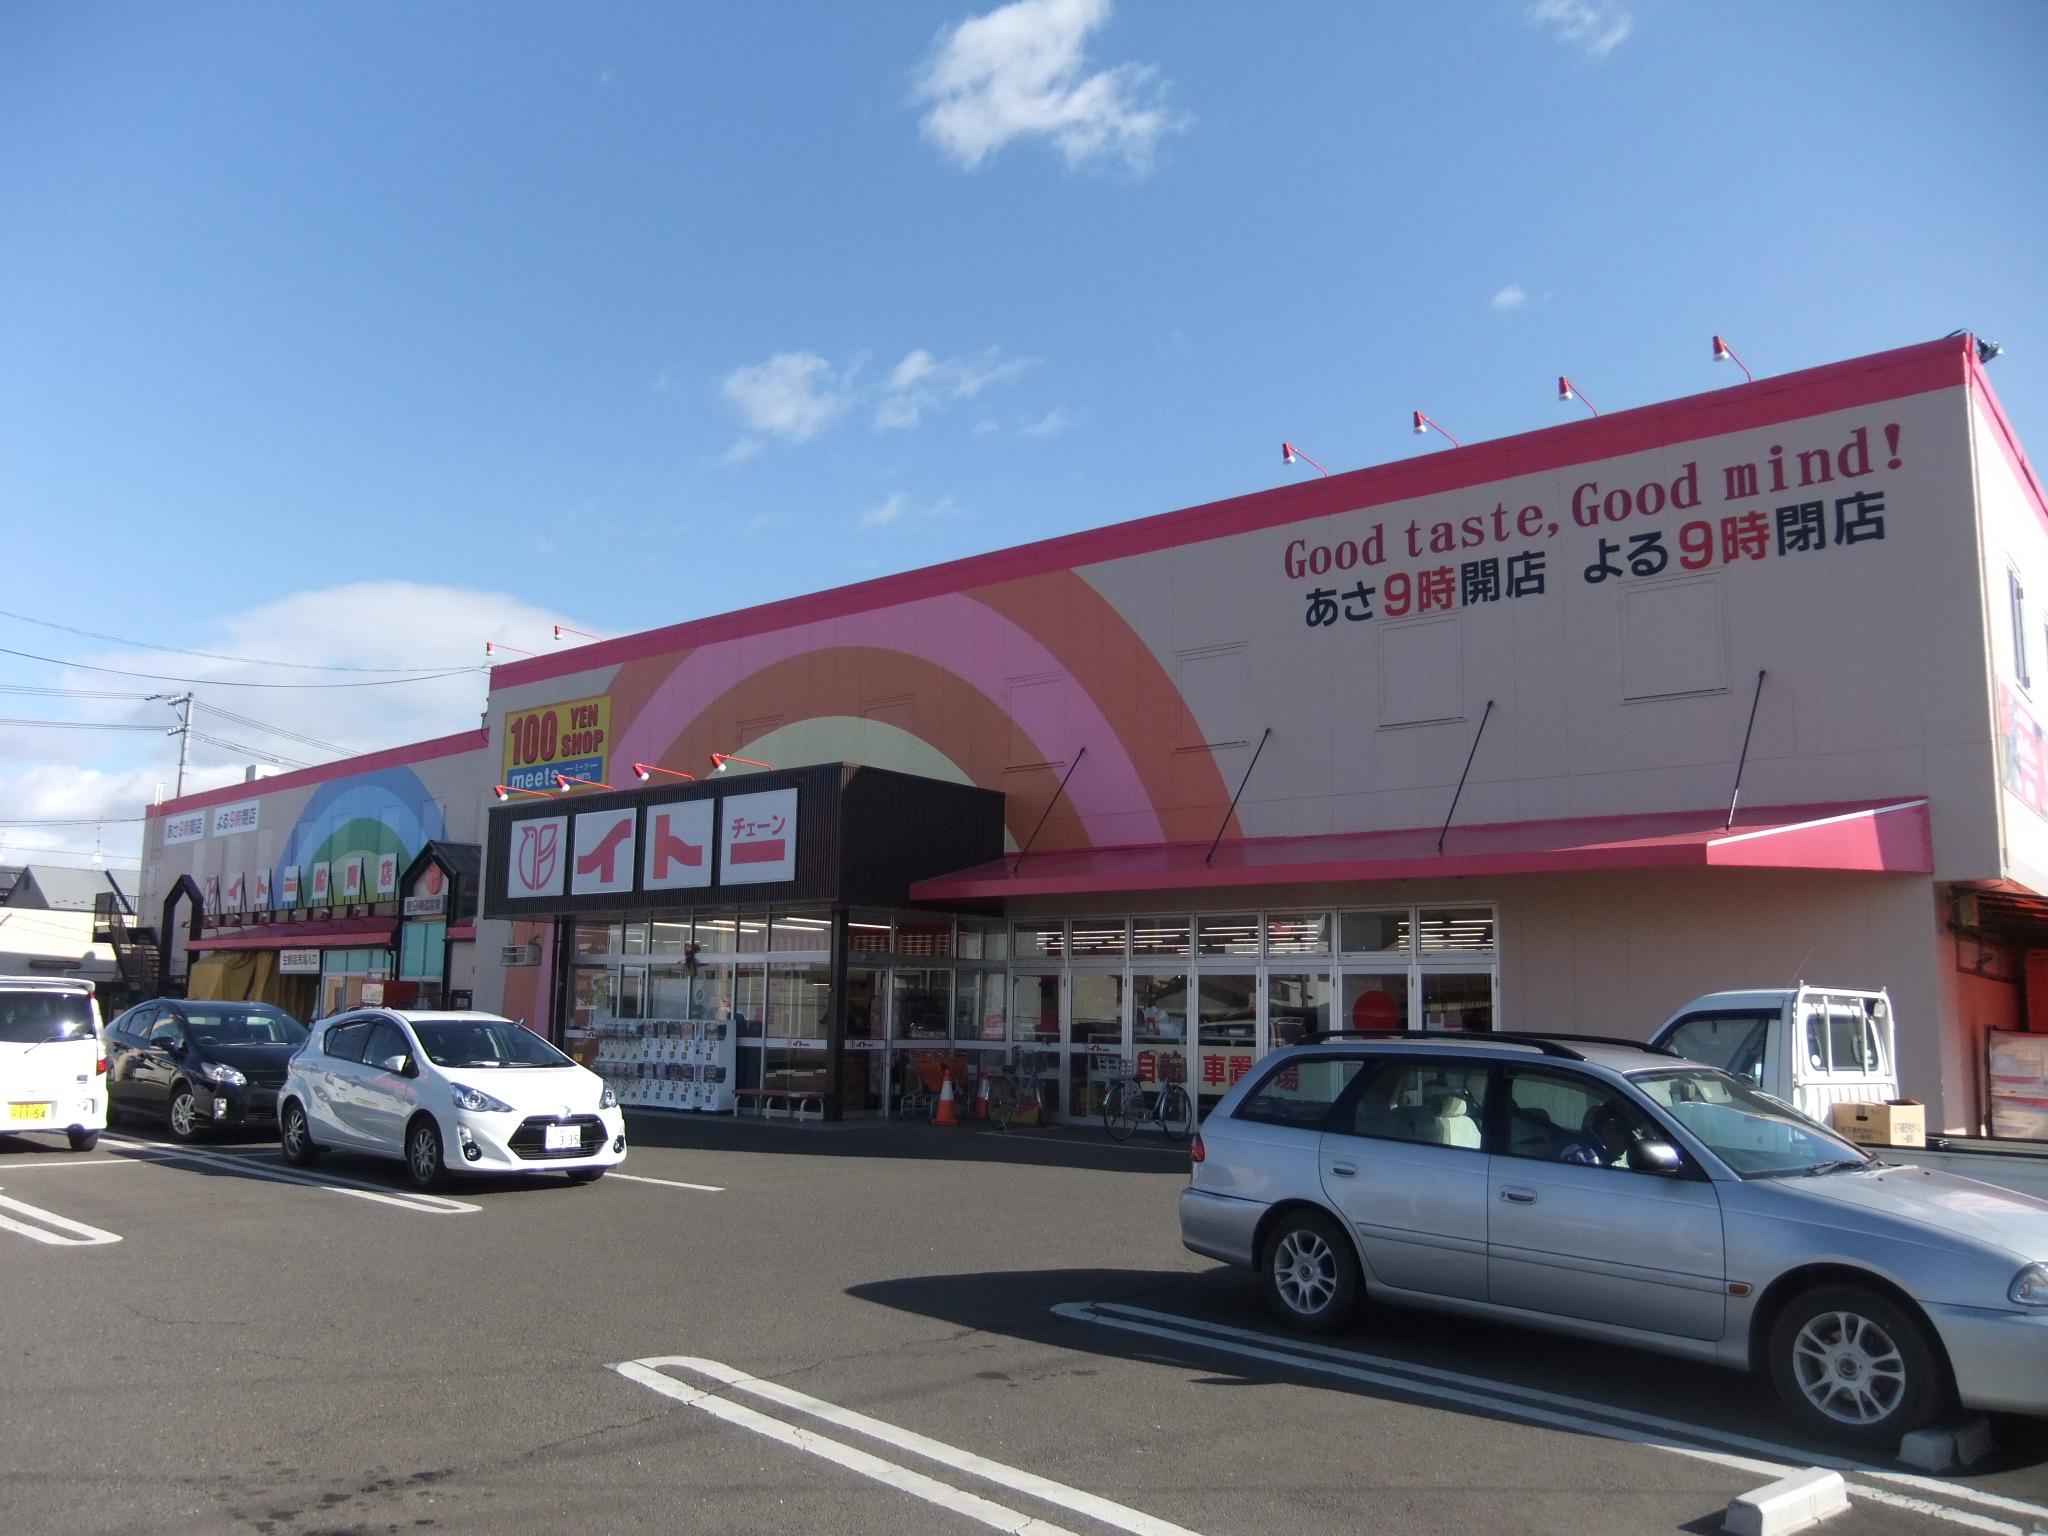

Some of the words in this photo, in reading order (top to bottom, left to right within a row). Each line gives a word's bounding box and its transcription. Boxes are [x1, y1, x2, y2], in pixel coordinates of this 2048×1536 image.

[1284, 524, 1387, 580] Good
[1404, 502, 1560, 559] taste,
[1571, 461, 1702, 528] Good
[1723, 422, 1905, 501] mind!
[1304, 550, 1546, 628] あさ9時開店
[1583, 490, 1886, 585] よる9時閉店
[511, 710, 557, 765] 100
[570, 703, 599, 729] YEN
[561, 729, 604, 757] SHOP
[511, 767, 559, 788] meets
[731, 815, 786, 838] チェーン
